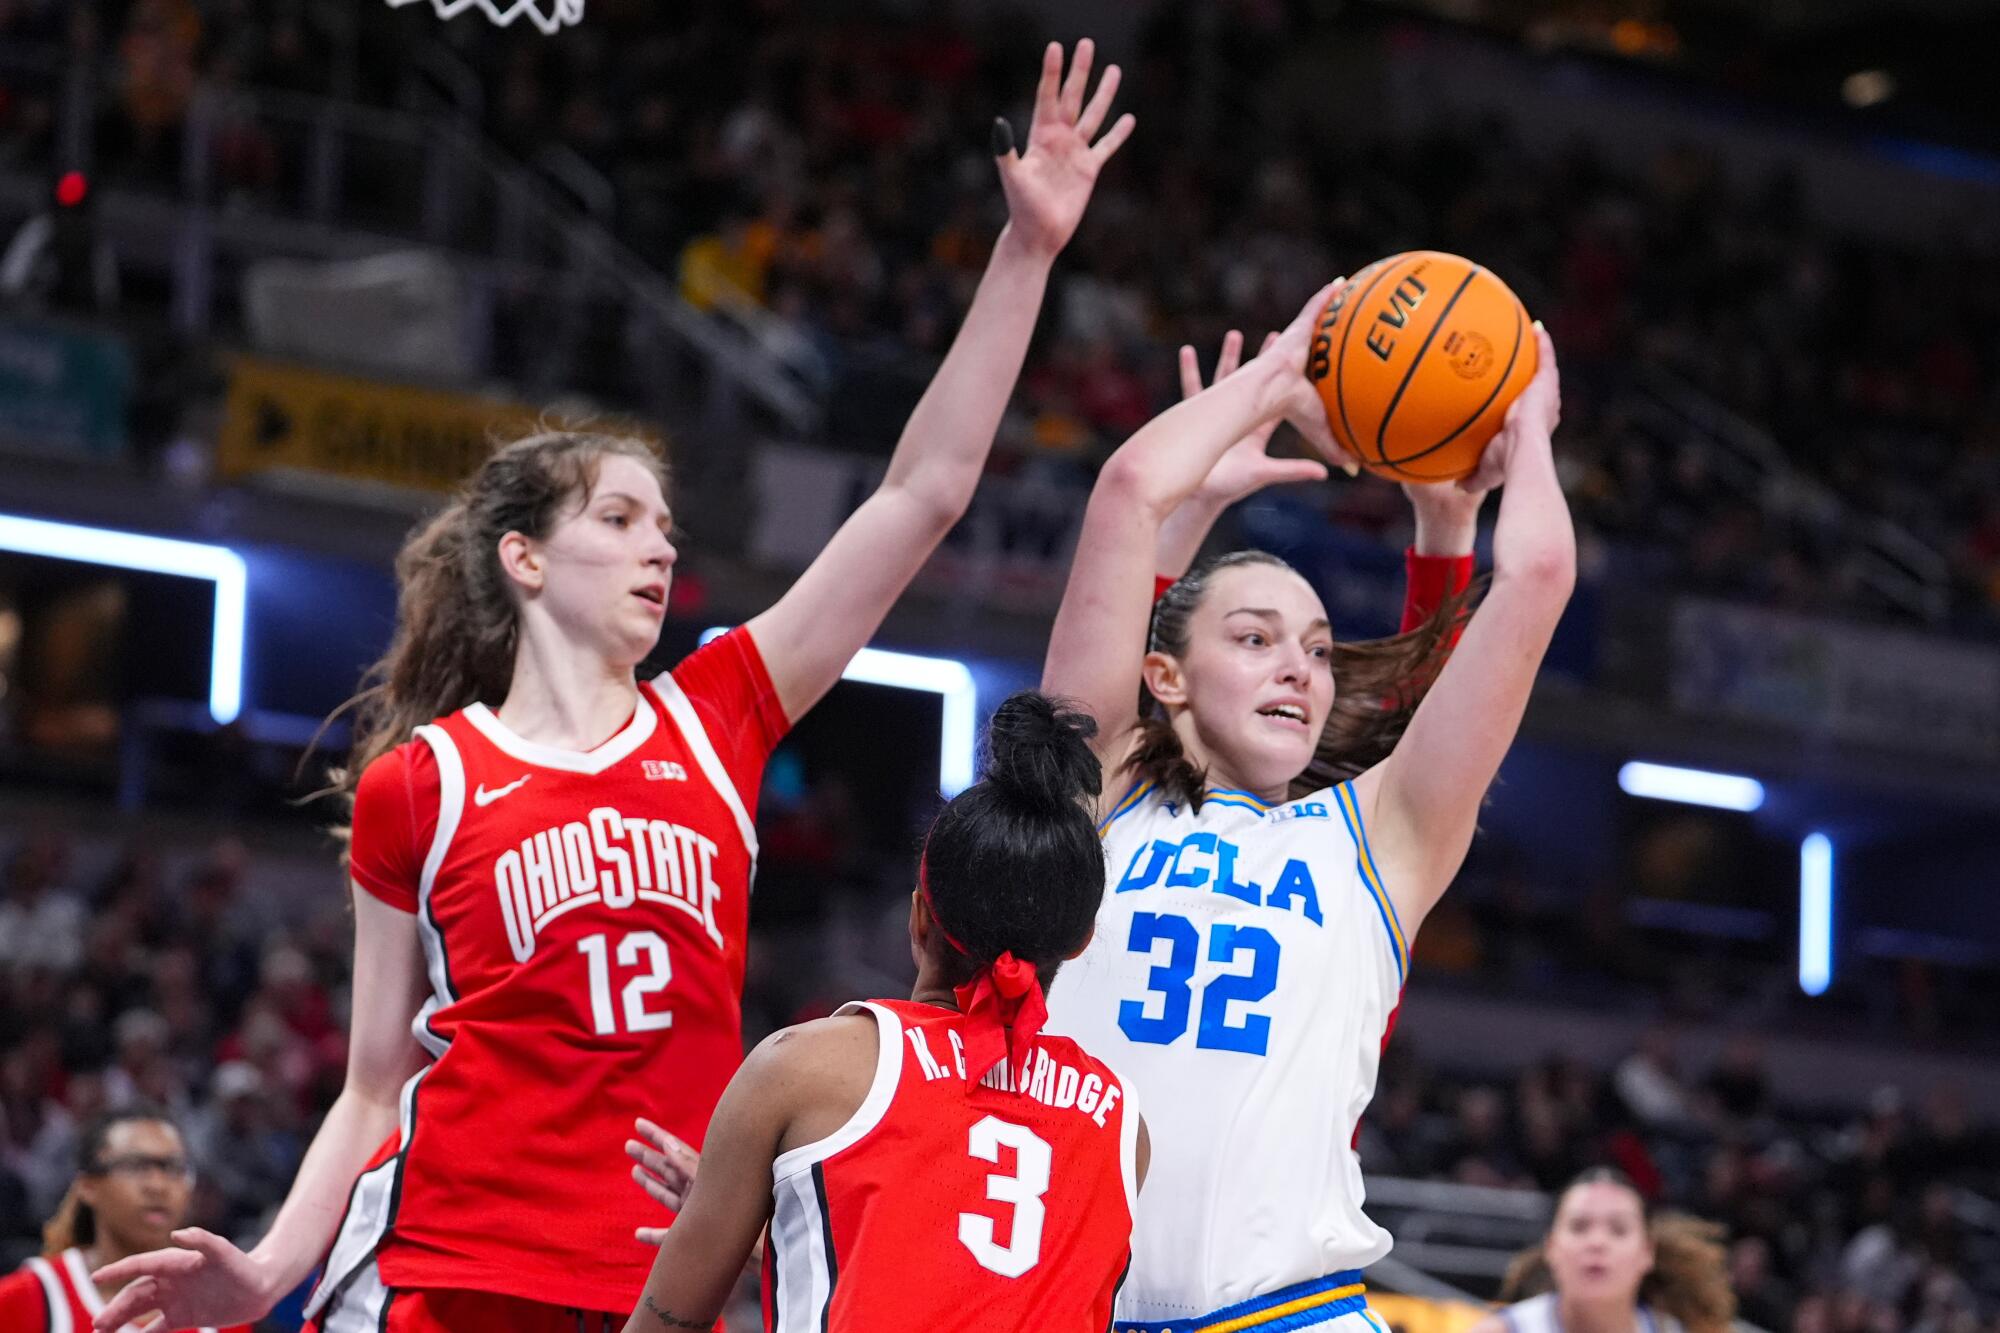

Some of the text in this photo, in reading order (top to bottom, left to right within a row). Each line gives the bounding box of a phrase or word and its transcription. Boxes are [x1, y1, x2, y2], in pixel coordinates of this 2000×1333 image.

[1366, 275, 1426, 362] EVO
[1115, 832, 1324, 928] UCLA
[577, 930, 673, 1036] 12
[1117, 911, 1281, 1057] 32
[947, 1028, 1121, 1128] CMBRIDGE
[958, 1115, 1053, 1279] 3
